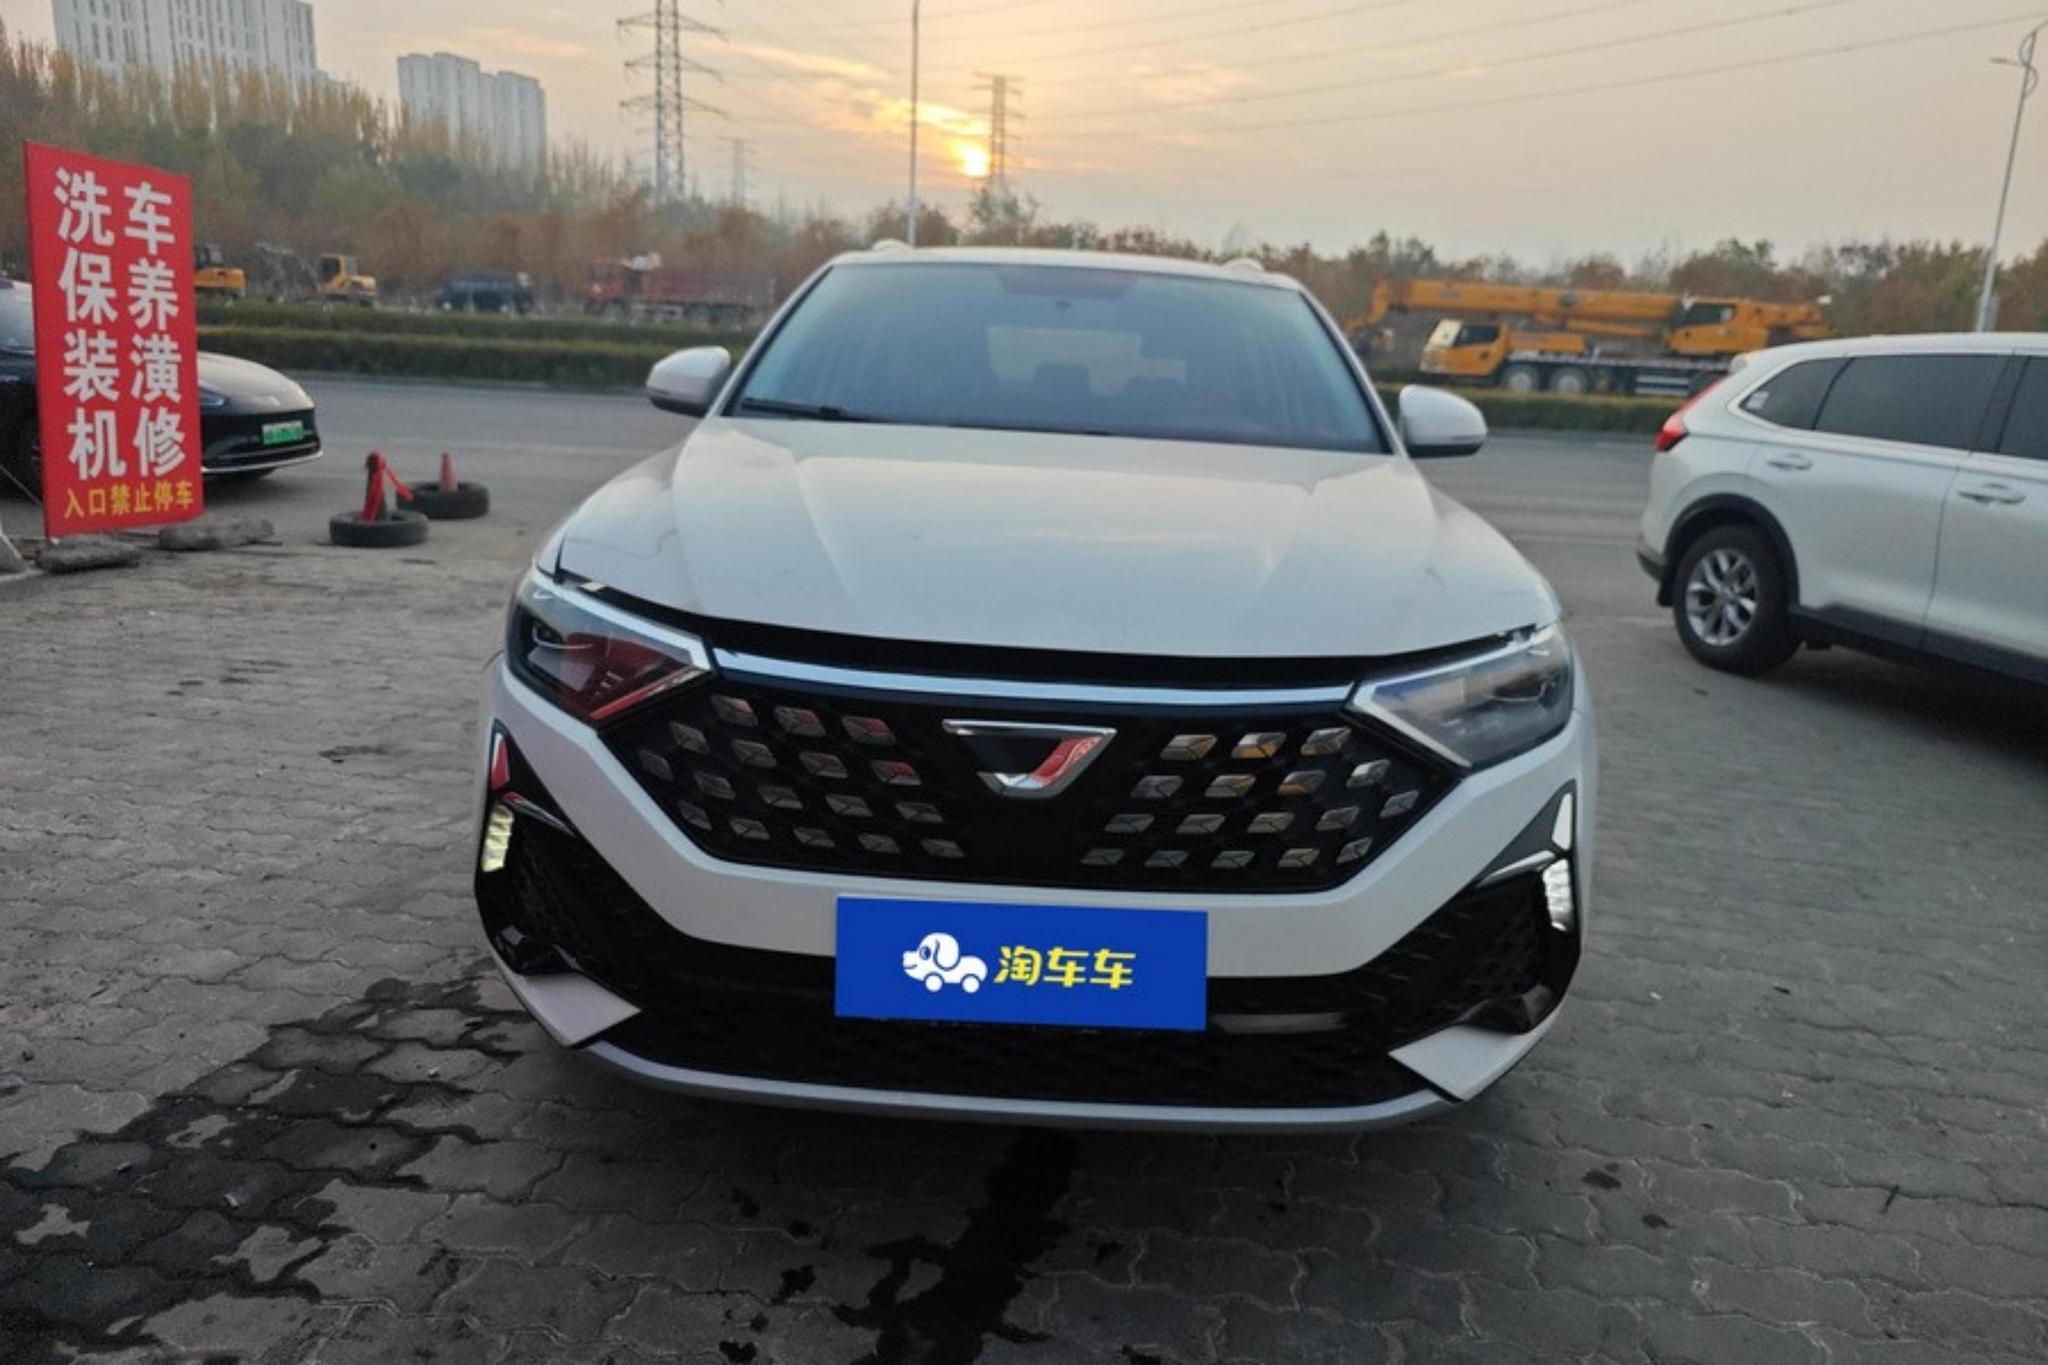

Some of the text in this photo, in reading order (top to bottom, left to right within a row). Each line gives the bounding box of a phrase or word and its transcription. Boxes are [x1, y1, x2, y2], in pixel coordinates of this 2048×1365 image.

[54, 167, 175, 255] 洗车
[58, 248, 179, 330] 保养
[63, 328, 182, 403] 装潢
[67, 407, 186, 480] 机修
[64, 480, 194, 519] 入口禁止停车
